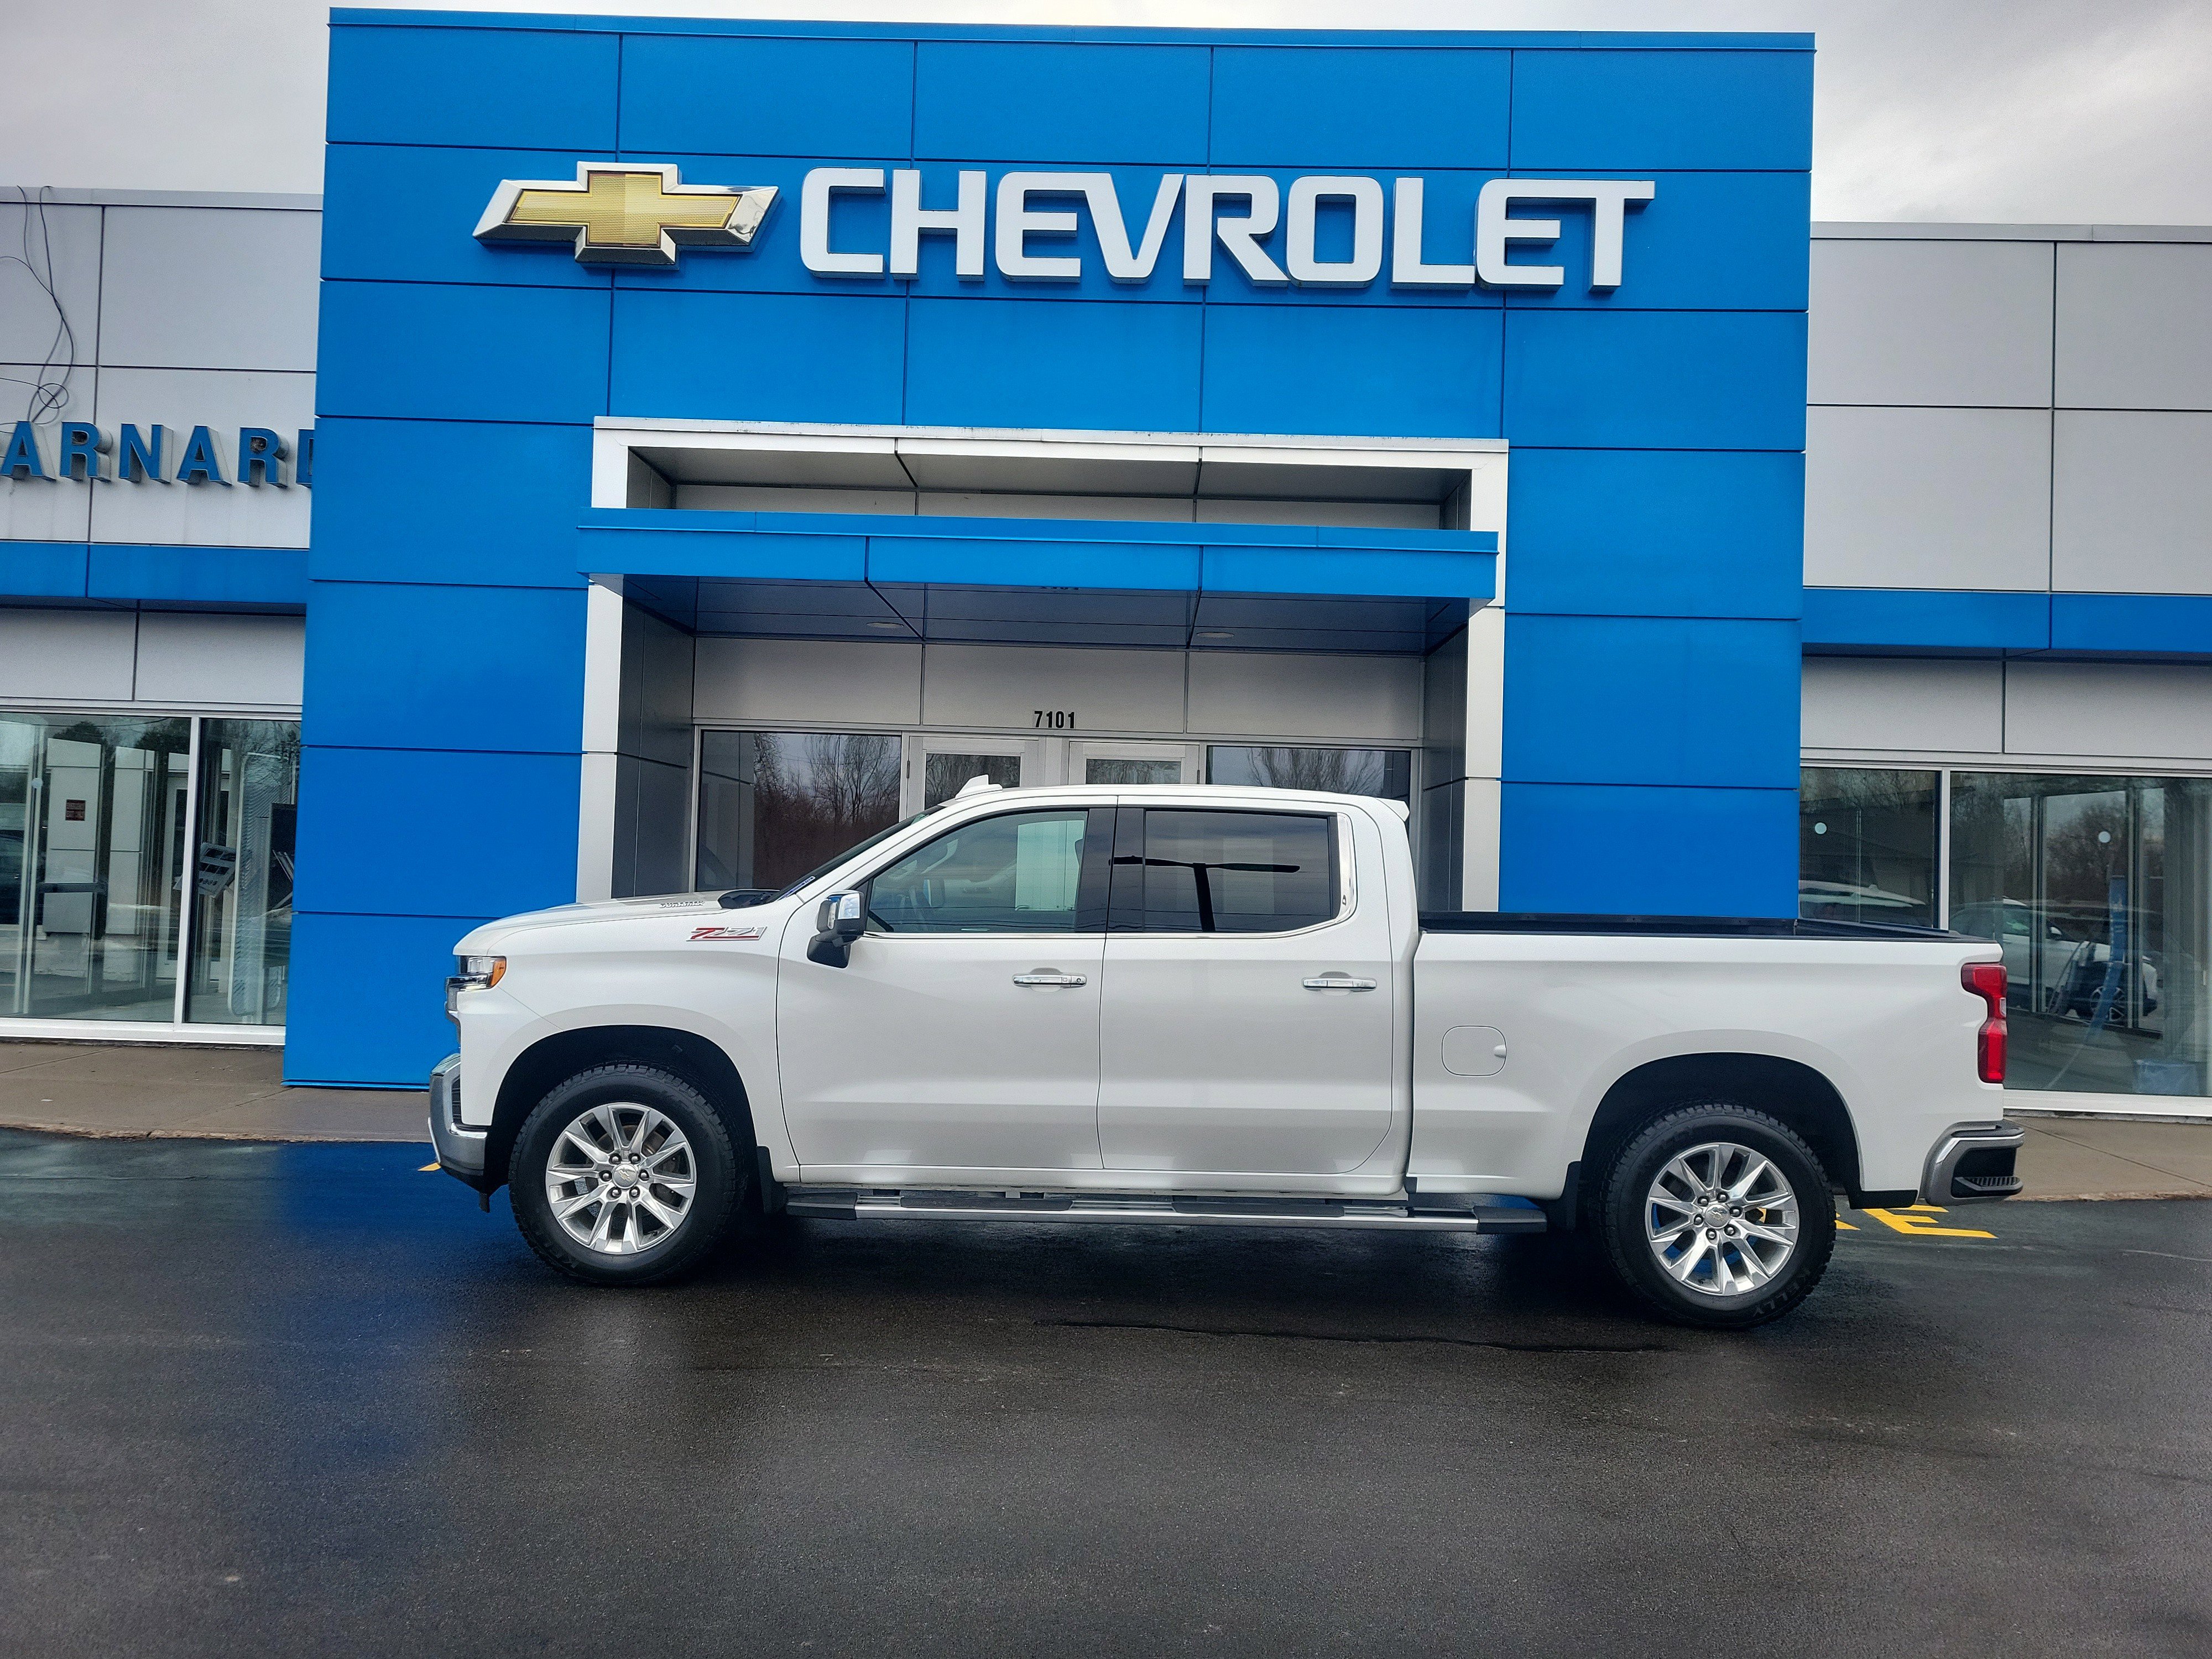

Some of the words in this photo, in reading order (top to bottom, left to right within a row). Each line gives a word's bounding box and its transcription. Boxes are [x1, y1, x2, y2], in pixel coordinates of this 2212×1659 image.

[800, 167, 1656, 293] CHEVROLET
[1034, 711, 1074, 728] 7101
[686, 926, 768, 941] Z71
